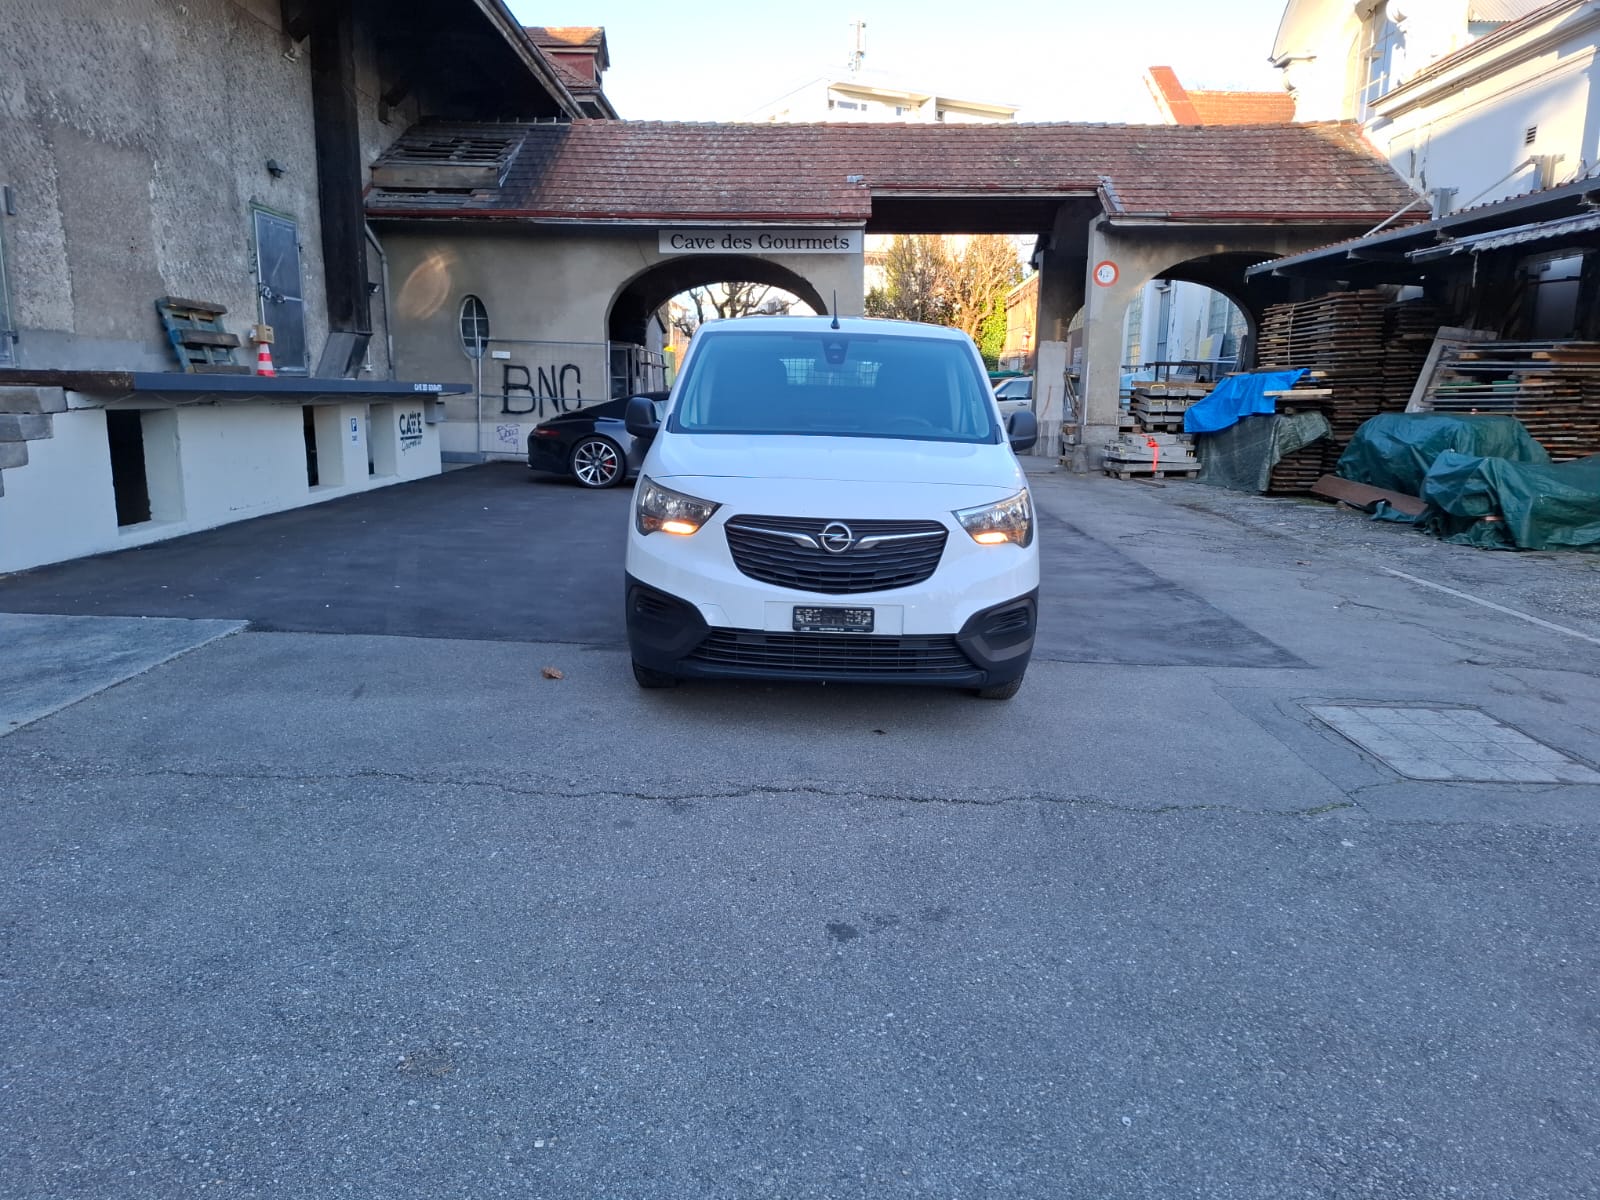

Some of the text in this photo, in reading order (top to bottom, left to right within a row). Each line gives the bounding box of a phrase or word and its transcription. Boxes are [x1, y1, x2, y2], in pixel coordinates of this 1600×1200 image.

[670, 233, 849, 250] Cave des Gourmets
